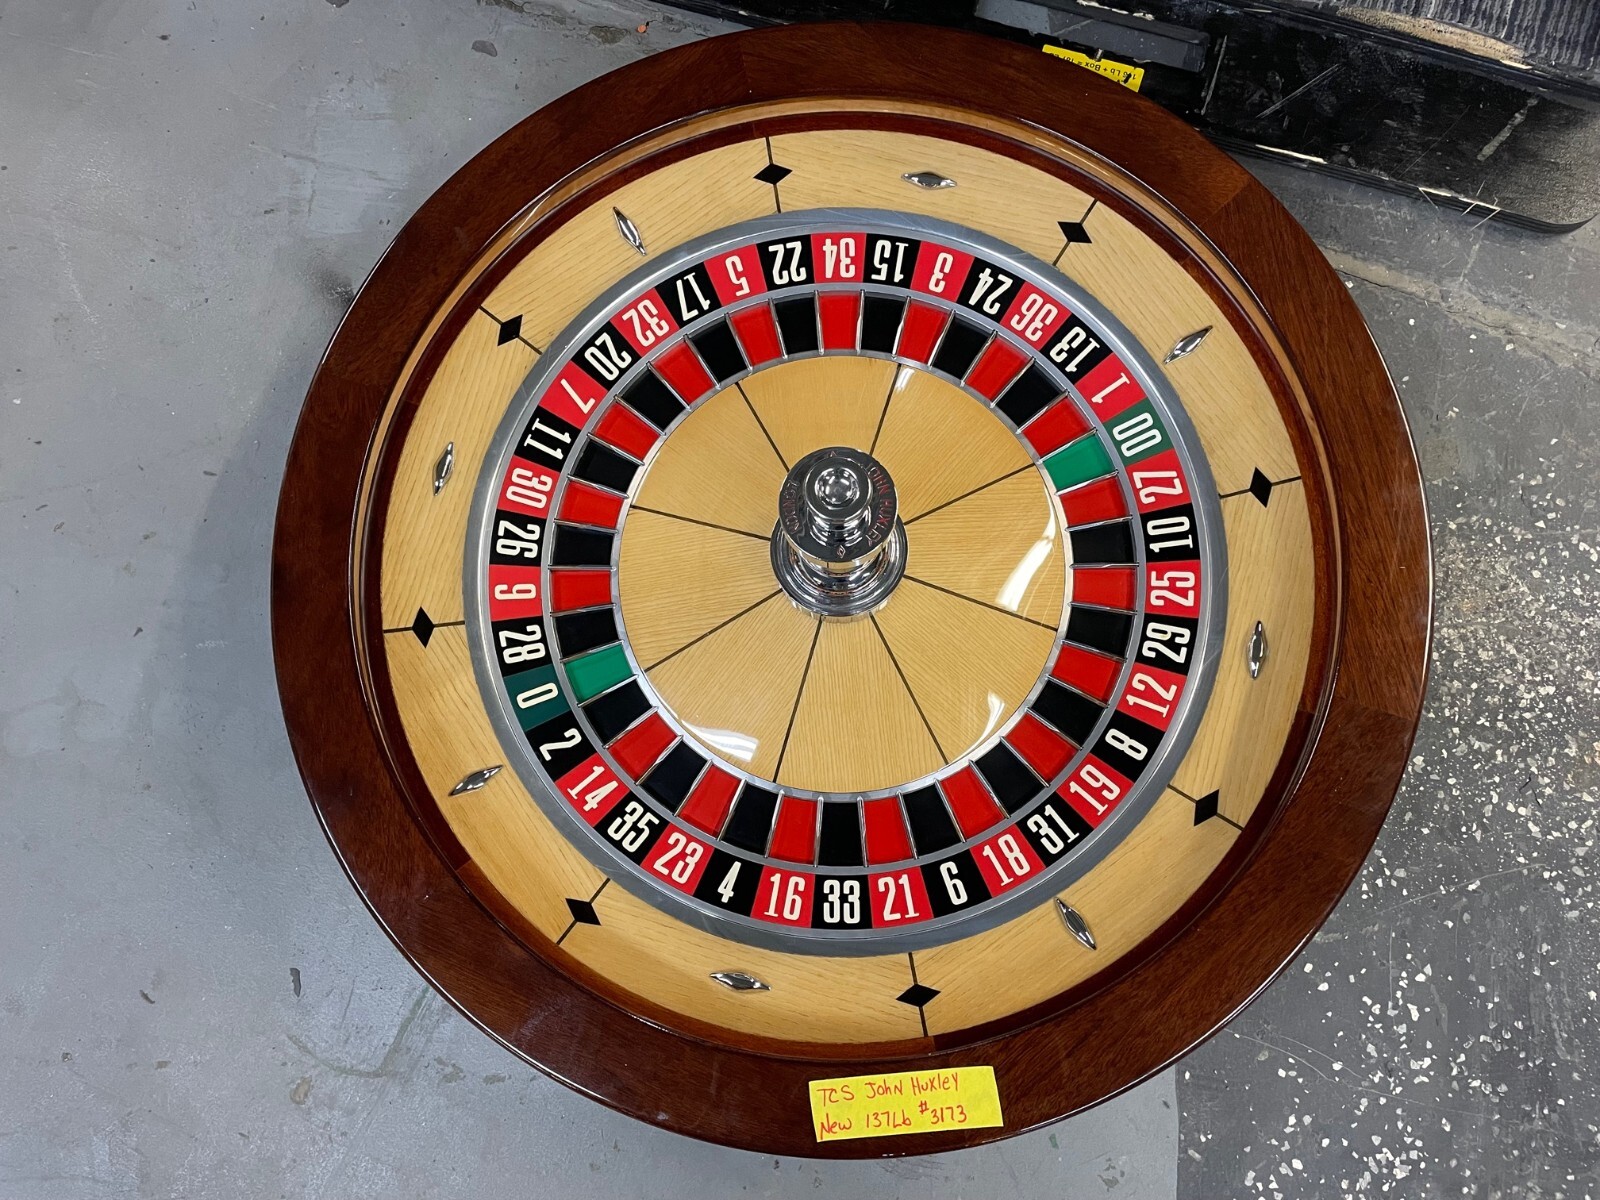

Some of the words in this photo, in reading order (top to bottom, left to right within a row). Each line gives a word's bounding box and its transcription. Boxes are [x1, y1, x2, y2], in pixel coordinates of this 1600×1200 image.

[1084, 61, 1101, 72] Box
[725, 255, 751, 297] 5
[768, 240, 807, 285] 22
[822, 237, 856, 279] 34
[870, 239, 909, 283] 15
[928, 252, 954, 293] 3
[675, 272, 711, 322] 17
[968, 267, 1014, 315] 24
[621, 299, 670, 347] 32
[1010, 293, 1059, 342] 36
[584, 332, 632, 381] 20
[1049, 326, 1101, 373] 13
[560, 378, 596, 415] 7
[1091, 372, 1131, 404] 1
[523, 417, 572, 460] 11
[1112, 412, 1163, 458] 00
[505, 467, 553, 509] 30
[865, 463, 890, 495] JOHN
[1132, 470, 1184, 505] 27
[495, 520, 541, 559] 26
[866, 500, 893, 547] HUXLEY
[1146, 516, 1194, 553] 10
[494, 583, 537, 601] 9
[1150, 570, 1196, 607] 25
[498, 624, 546, 664] 28
[1141, 622, 1191, 664] 29
[516, 682, 559, 709] 0
[1125, 672, 1178, 718] 12
[539, 727, 582, 762] 2
[1104, 728, 1149, 761] 8
[567, 765, 619, 812] 14
[1069, 764, 1121, 816] 19
[607, 800, 660, 853] 35
[1026, 804, 1080, 855] 31
[652, 831, 704, 884] 23
[982, 833, 1031, 887] 18
[717, 860, 742, 904] 4
[764, 873, 806, 921] 16
[823, 879, 861, 924] 33
[877, 873, 920, 921] 21
[939, 861, 968, 906] 6
[816, 1085, 855, 1107] TCS
[819, 1113, 853, 1140] New
[918, 1100, 968, 1125] #3173
